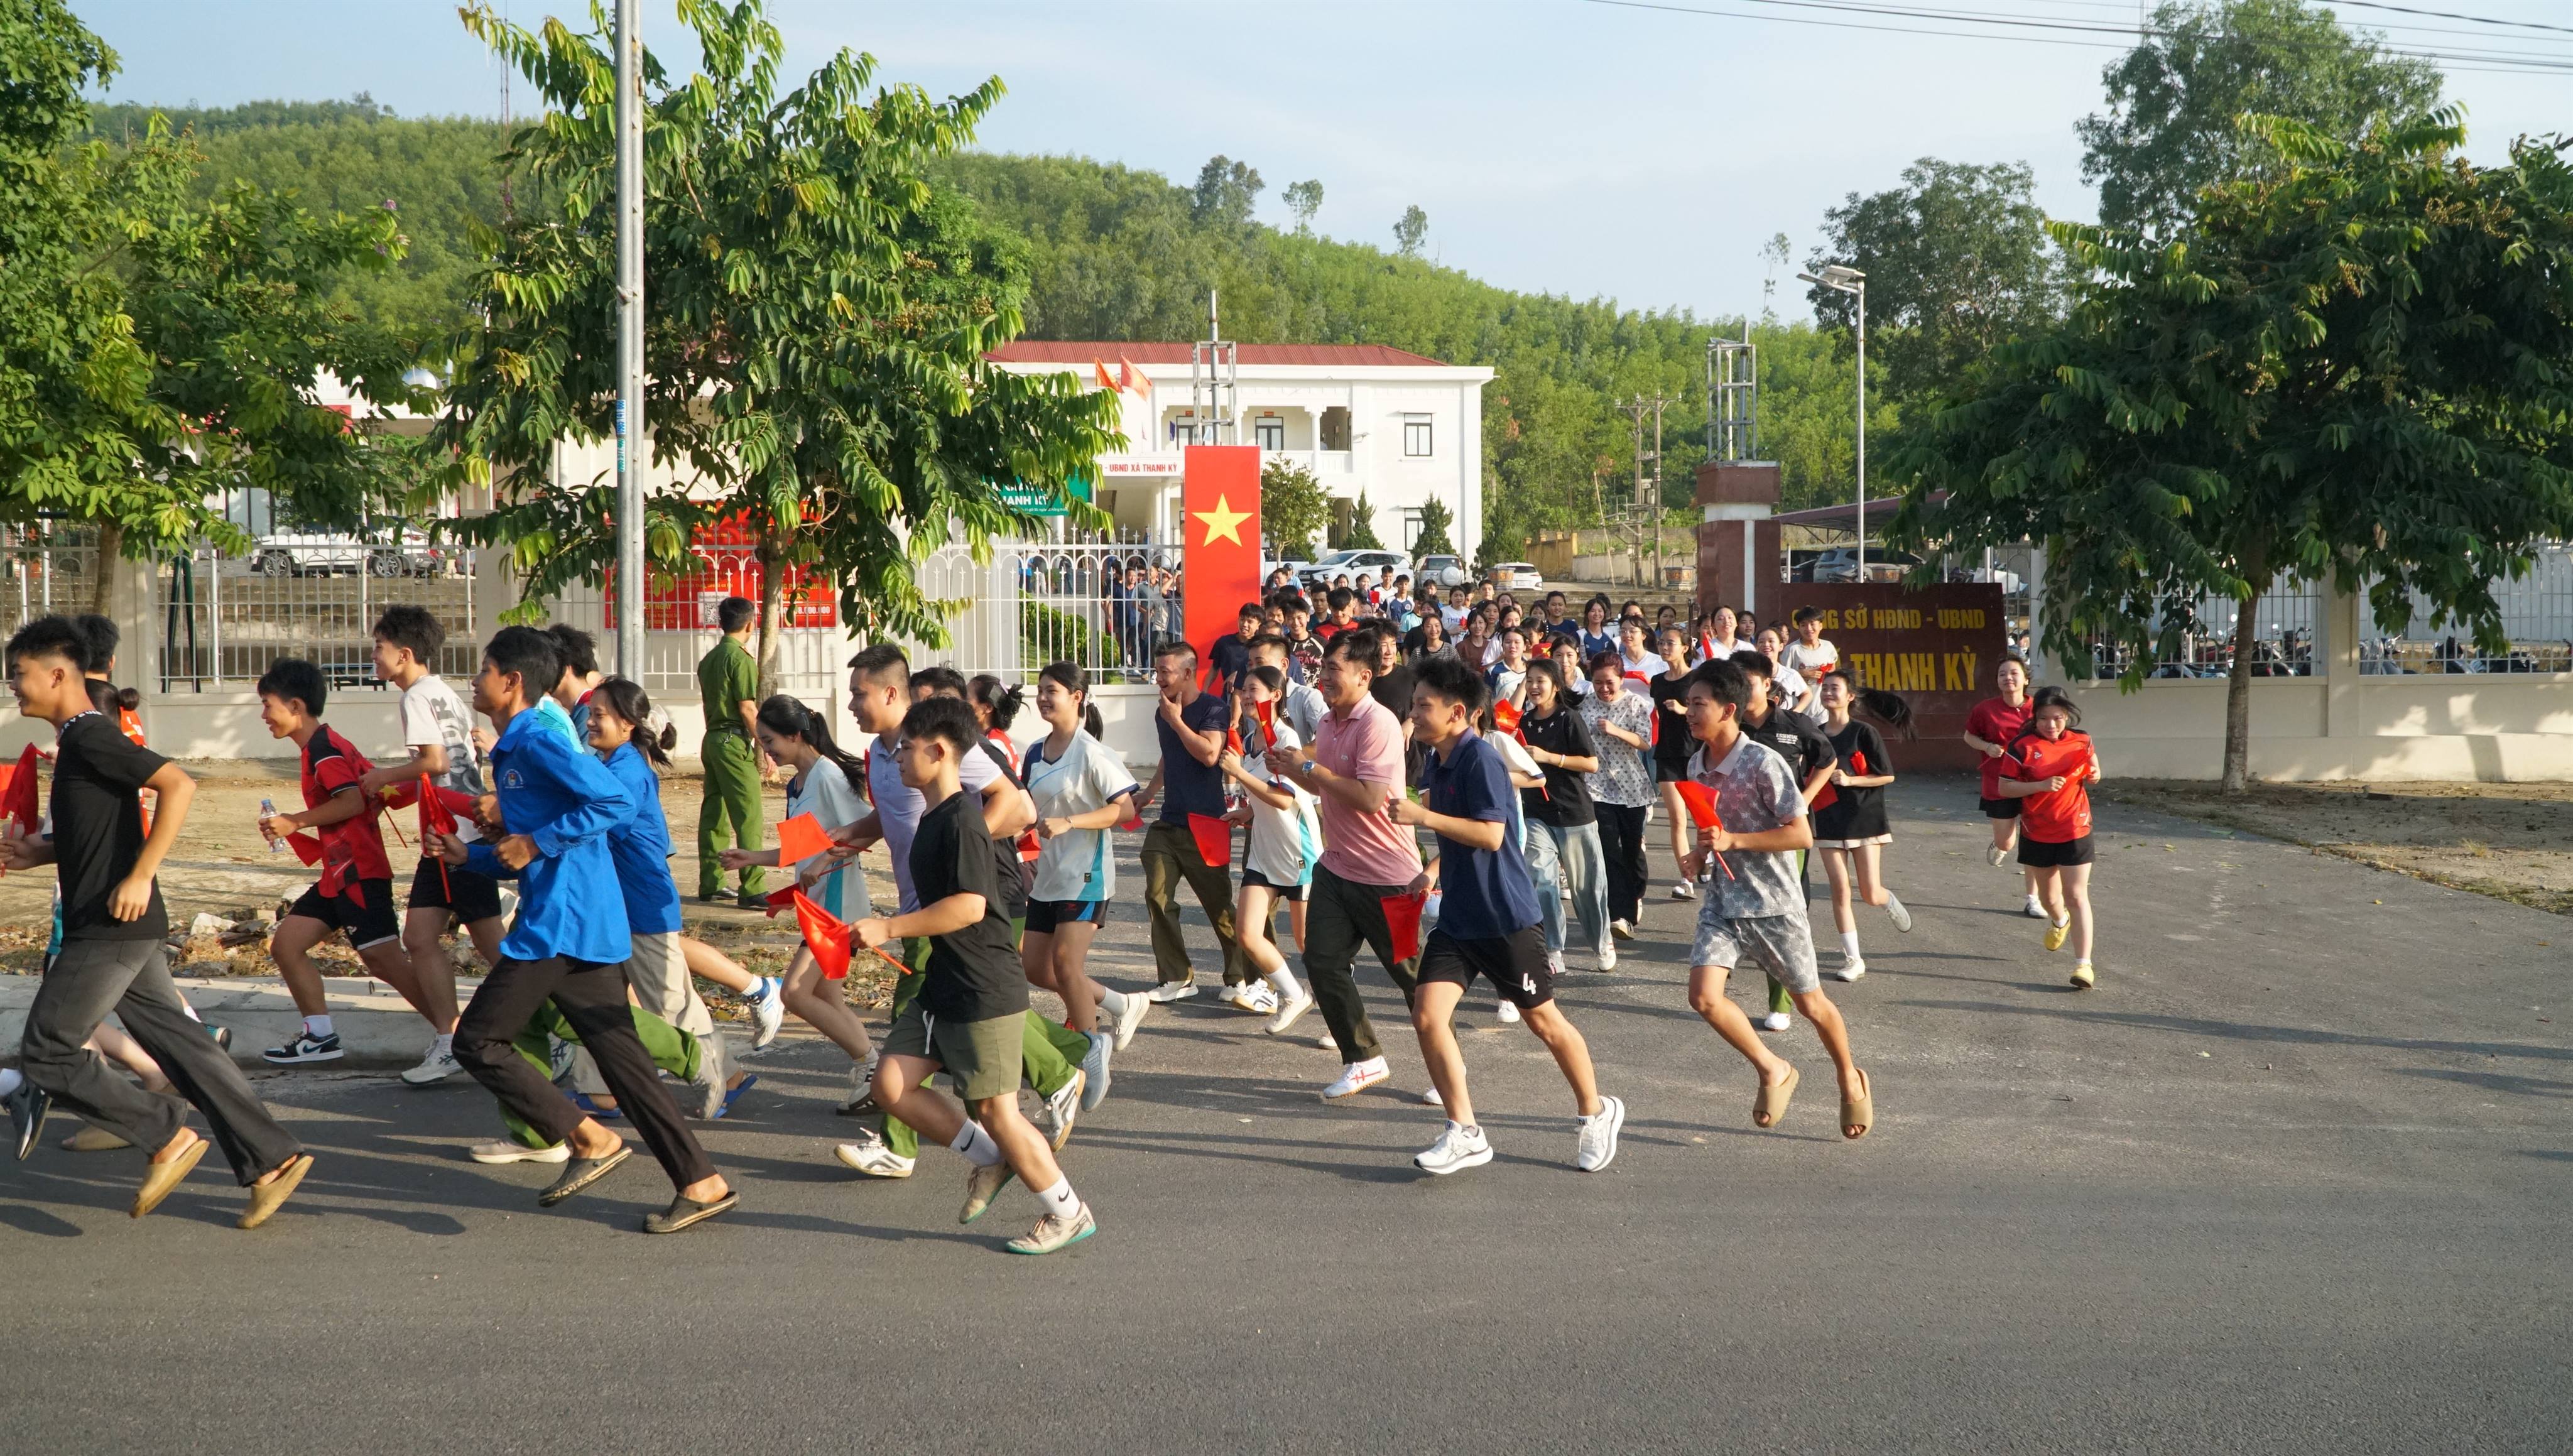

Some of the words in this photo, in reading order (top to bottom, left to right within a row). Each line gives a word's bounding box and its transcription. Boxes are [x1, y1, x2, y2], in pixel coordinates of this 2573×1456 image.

[1109, 464, 1129, 472] UBND
[1143, 464, 1166, 472] THANH
[1844, 603, 1868, 629] SỞ
[1873, 609, 1922, 629] HĐND
[1938, 609, 1986, 629] UBND
[1850, 653, 1936, 691] THANH
[1944, 645, 1977, 691] KỲ
[1523, 972, 1537, 995] 4
